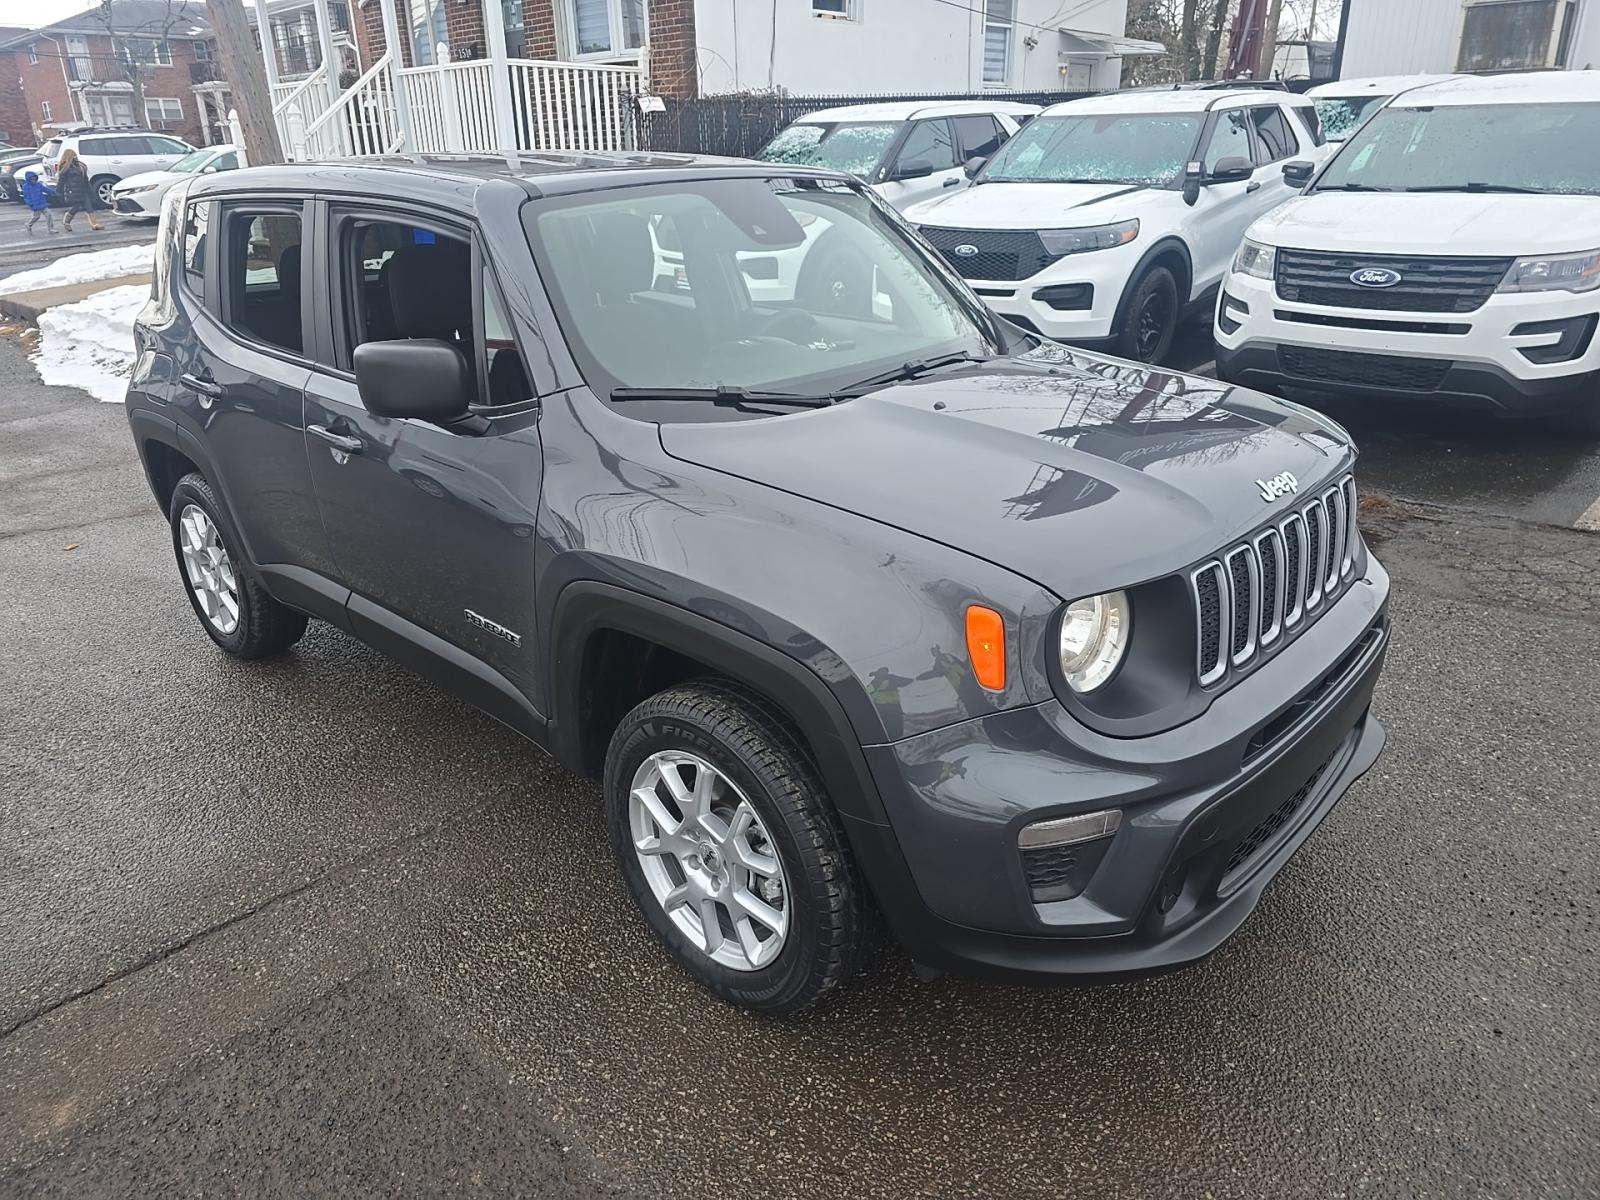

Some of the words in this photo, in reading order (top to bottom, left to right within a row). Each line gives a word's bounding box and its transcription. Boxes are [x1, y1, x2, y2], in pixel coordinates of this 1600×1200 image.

[1360, 270, 1389, 282] Ford
[1254, 471, 1298, 503] Jeep
[464, 609, 521, 648] RENEGADE
